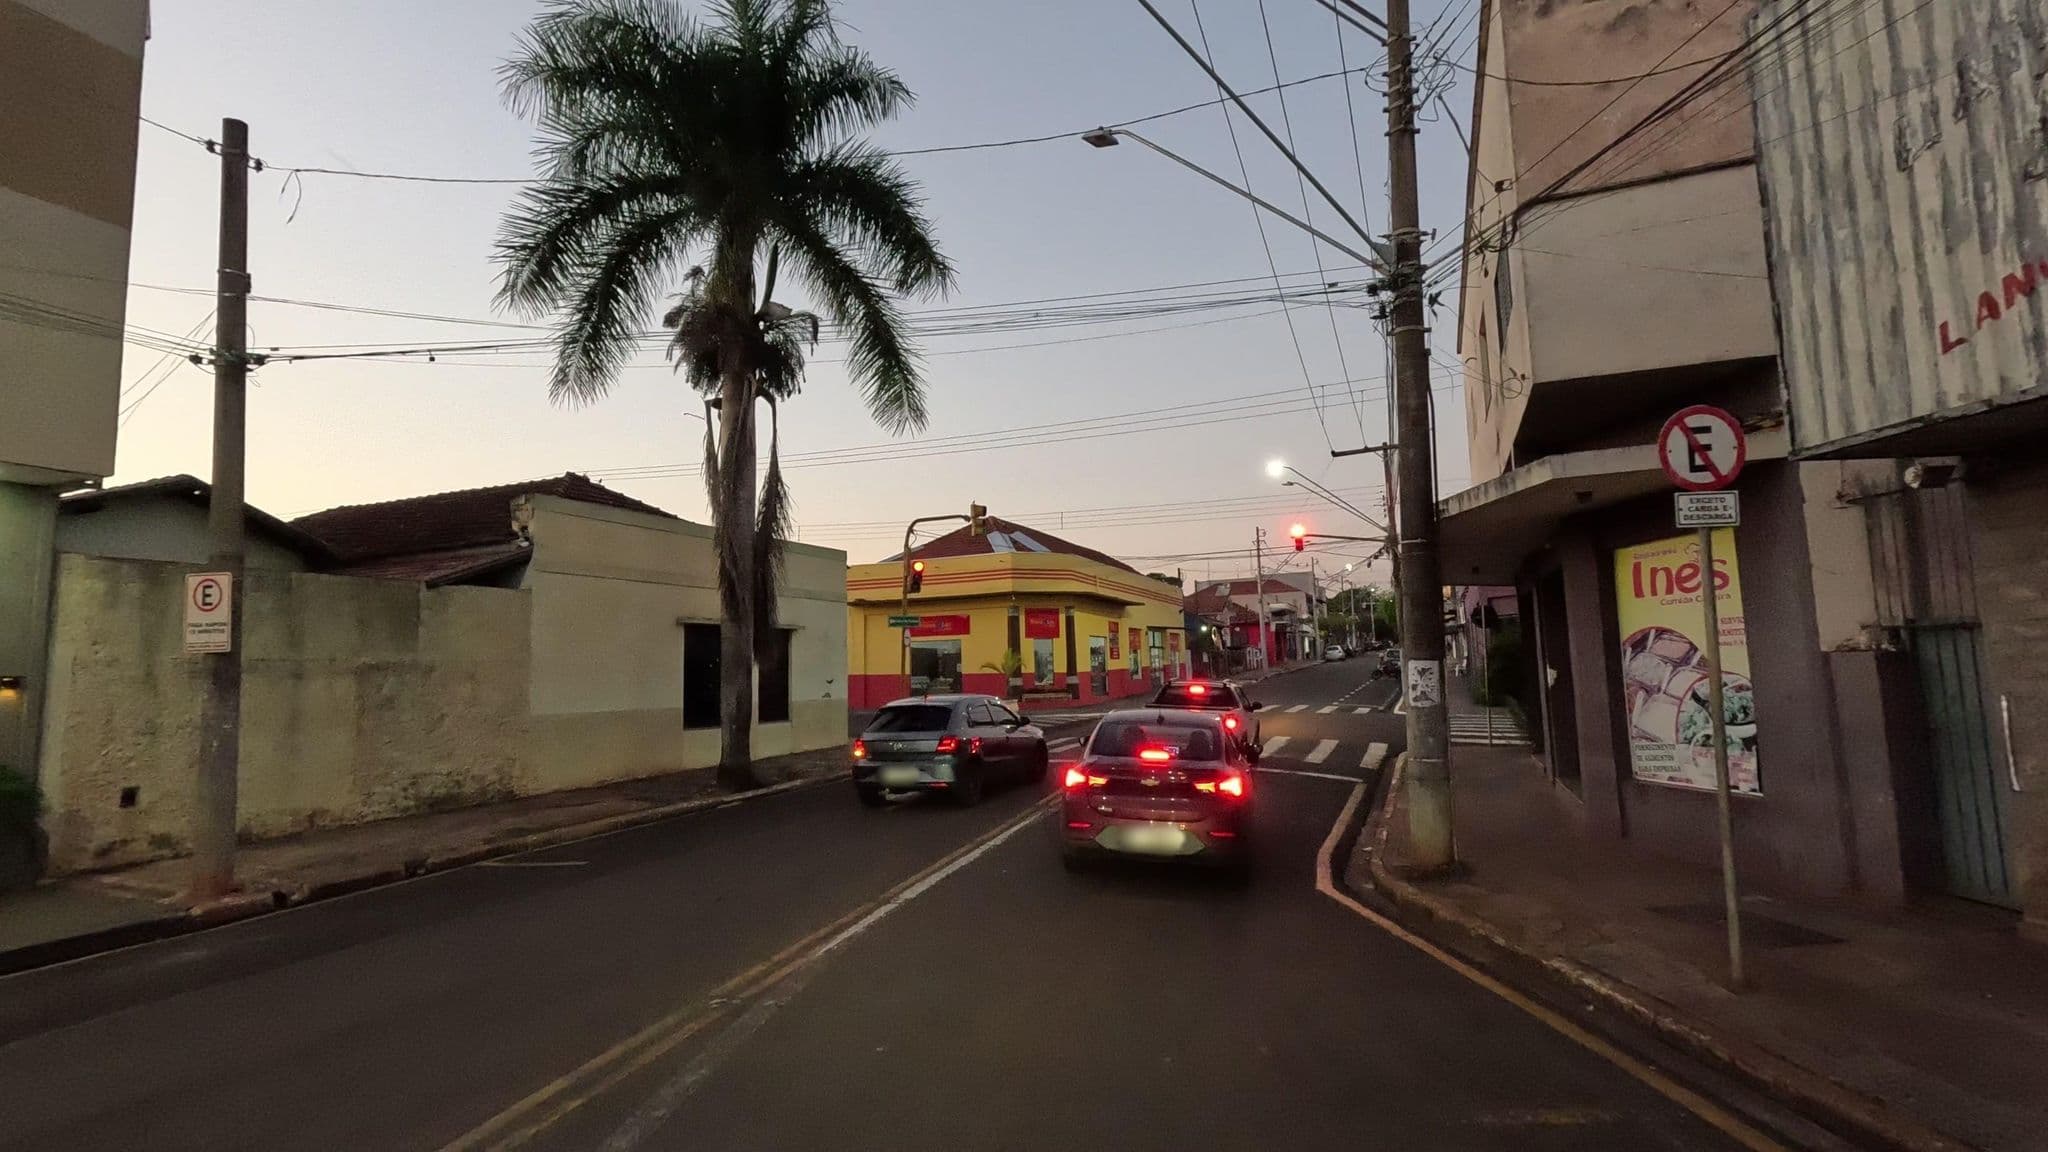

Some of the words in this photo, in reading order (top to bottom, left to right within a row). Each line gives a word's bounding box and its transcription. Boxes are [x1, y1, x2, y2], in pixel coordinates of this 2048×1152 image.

[1687, 425, 1713, 473] E
[1689, 496, 1727, 504] EXCETO
[1683, 513, 1734, 521] DESCARGA
[202, 585, 213, 606] E
